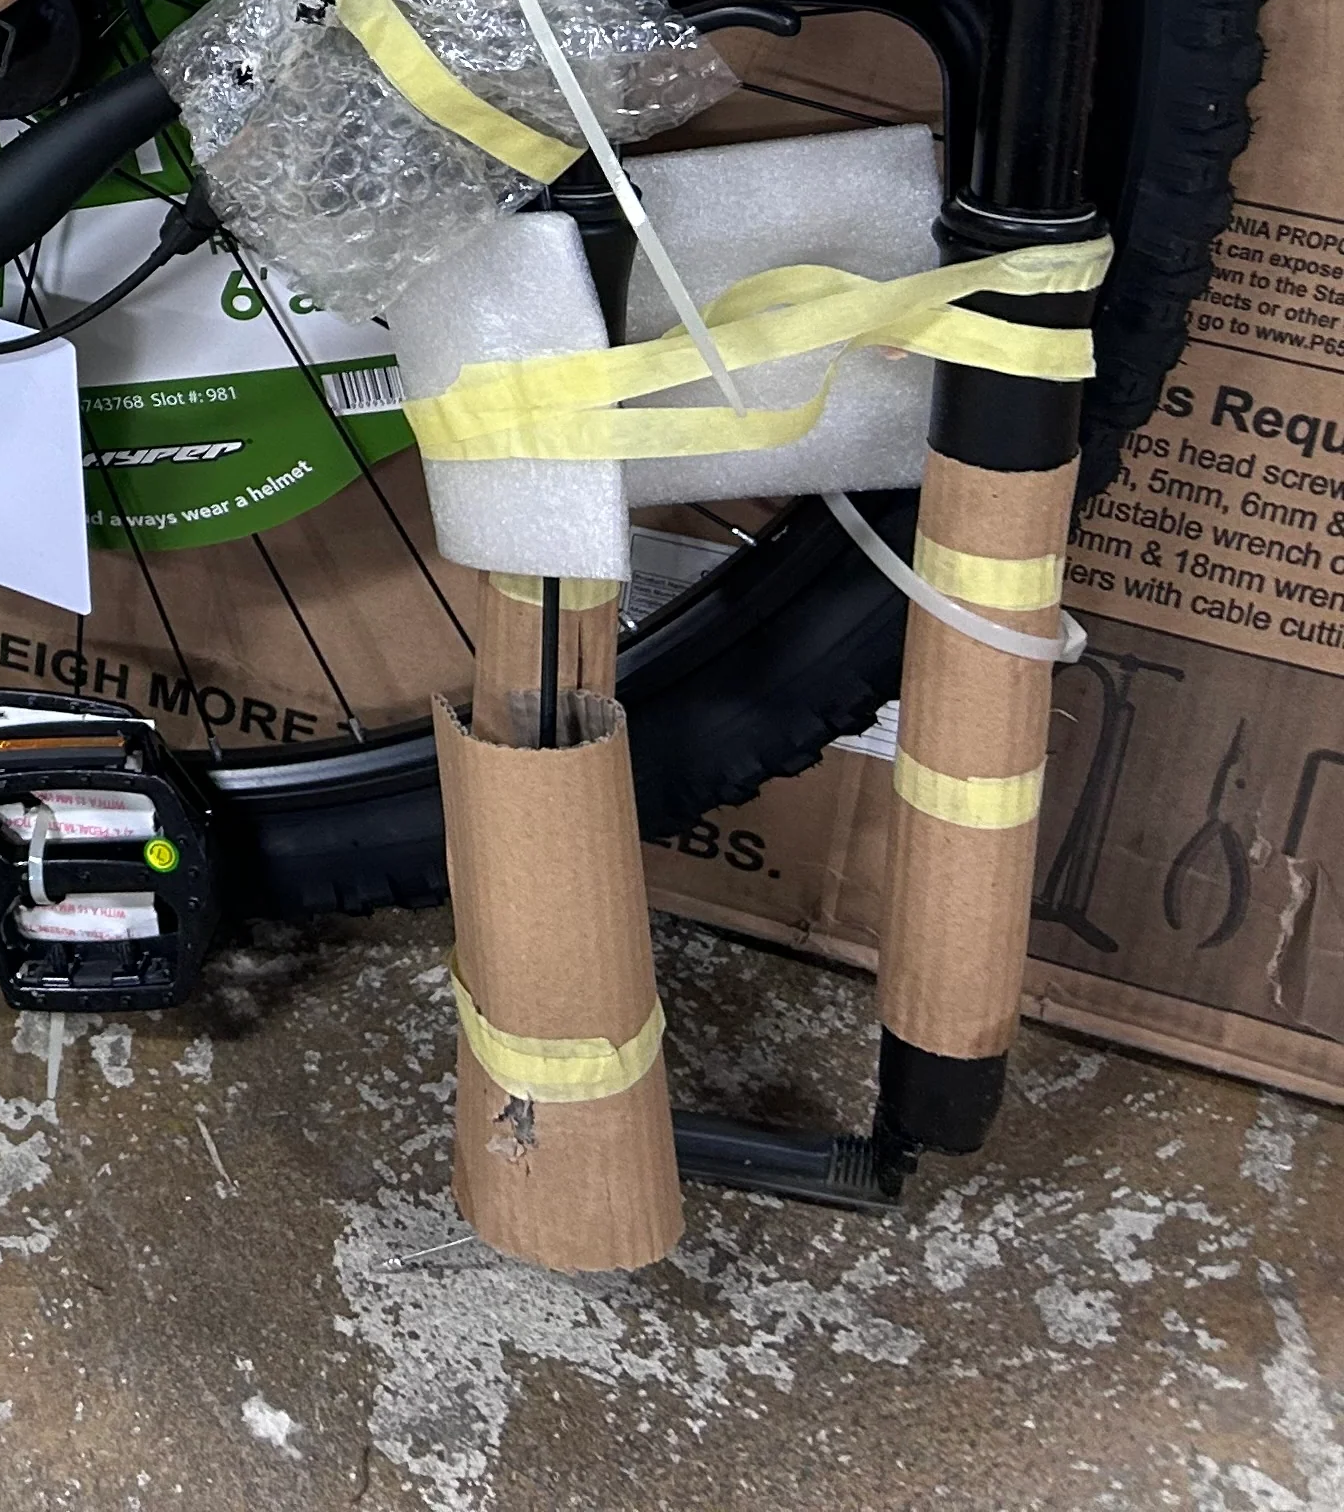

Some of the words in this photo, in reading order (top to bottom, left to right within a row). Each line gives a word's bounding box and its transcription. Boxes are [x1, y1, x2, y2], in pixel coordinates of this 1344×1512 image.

[1227, 243, 1264, 263] can
[1249, 270, 1270, 290] to
[1276, 276, 1308, 298] the
[1313, 283, 1344, 305] Sta
[1258, 301, 1280, 317] or
[1285, 307, 1341, 330] other
[1198, 313, 1225, 332] go
[1230, 317, 1250, 336] to
[81, 394, 145, 413] 743768
[152, 391, 185, 408] Slot
[188, 389, 204, 405] #:
[206, 386, 237, 403] 981
[1211, 384, 1344, 458] Requ
[1179, 437, 1256, 479] head
[110, 506, 177, 529] aways
[182, 499, 229, 523] wear
[236, 494, 248, 508] a
[245, 458, 313, 502] helmet
[1148, 467, 1230, 515] 5mm,
[1241, 490, 1318, 532] 6mm
[1083, 492, 1204, 540] justable
[1213, 525, 1322, 570] wrench
[1062, 556, 1115, 591] iers
[1124, 576, 1182, 609] with
[1191, 594, 1272, 630] cable
[1140, 539, 1163, 568] &
[1175, 548, 1265, 594] 18mm
[148, 673, 319, 744] MORE
[642, 819, 781, 880] BS.
